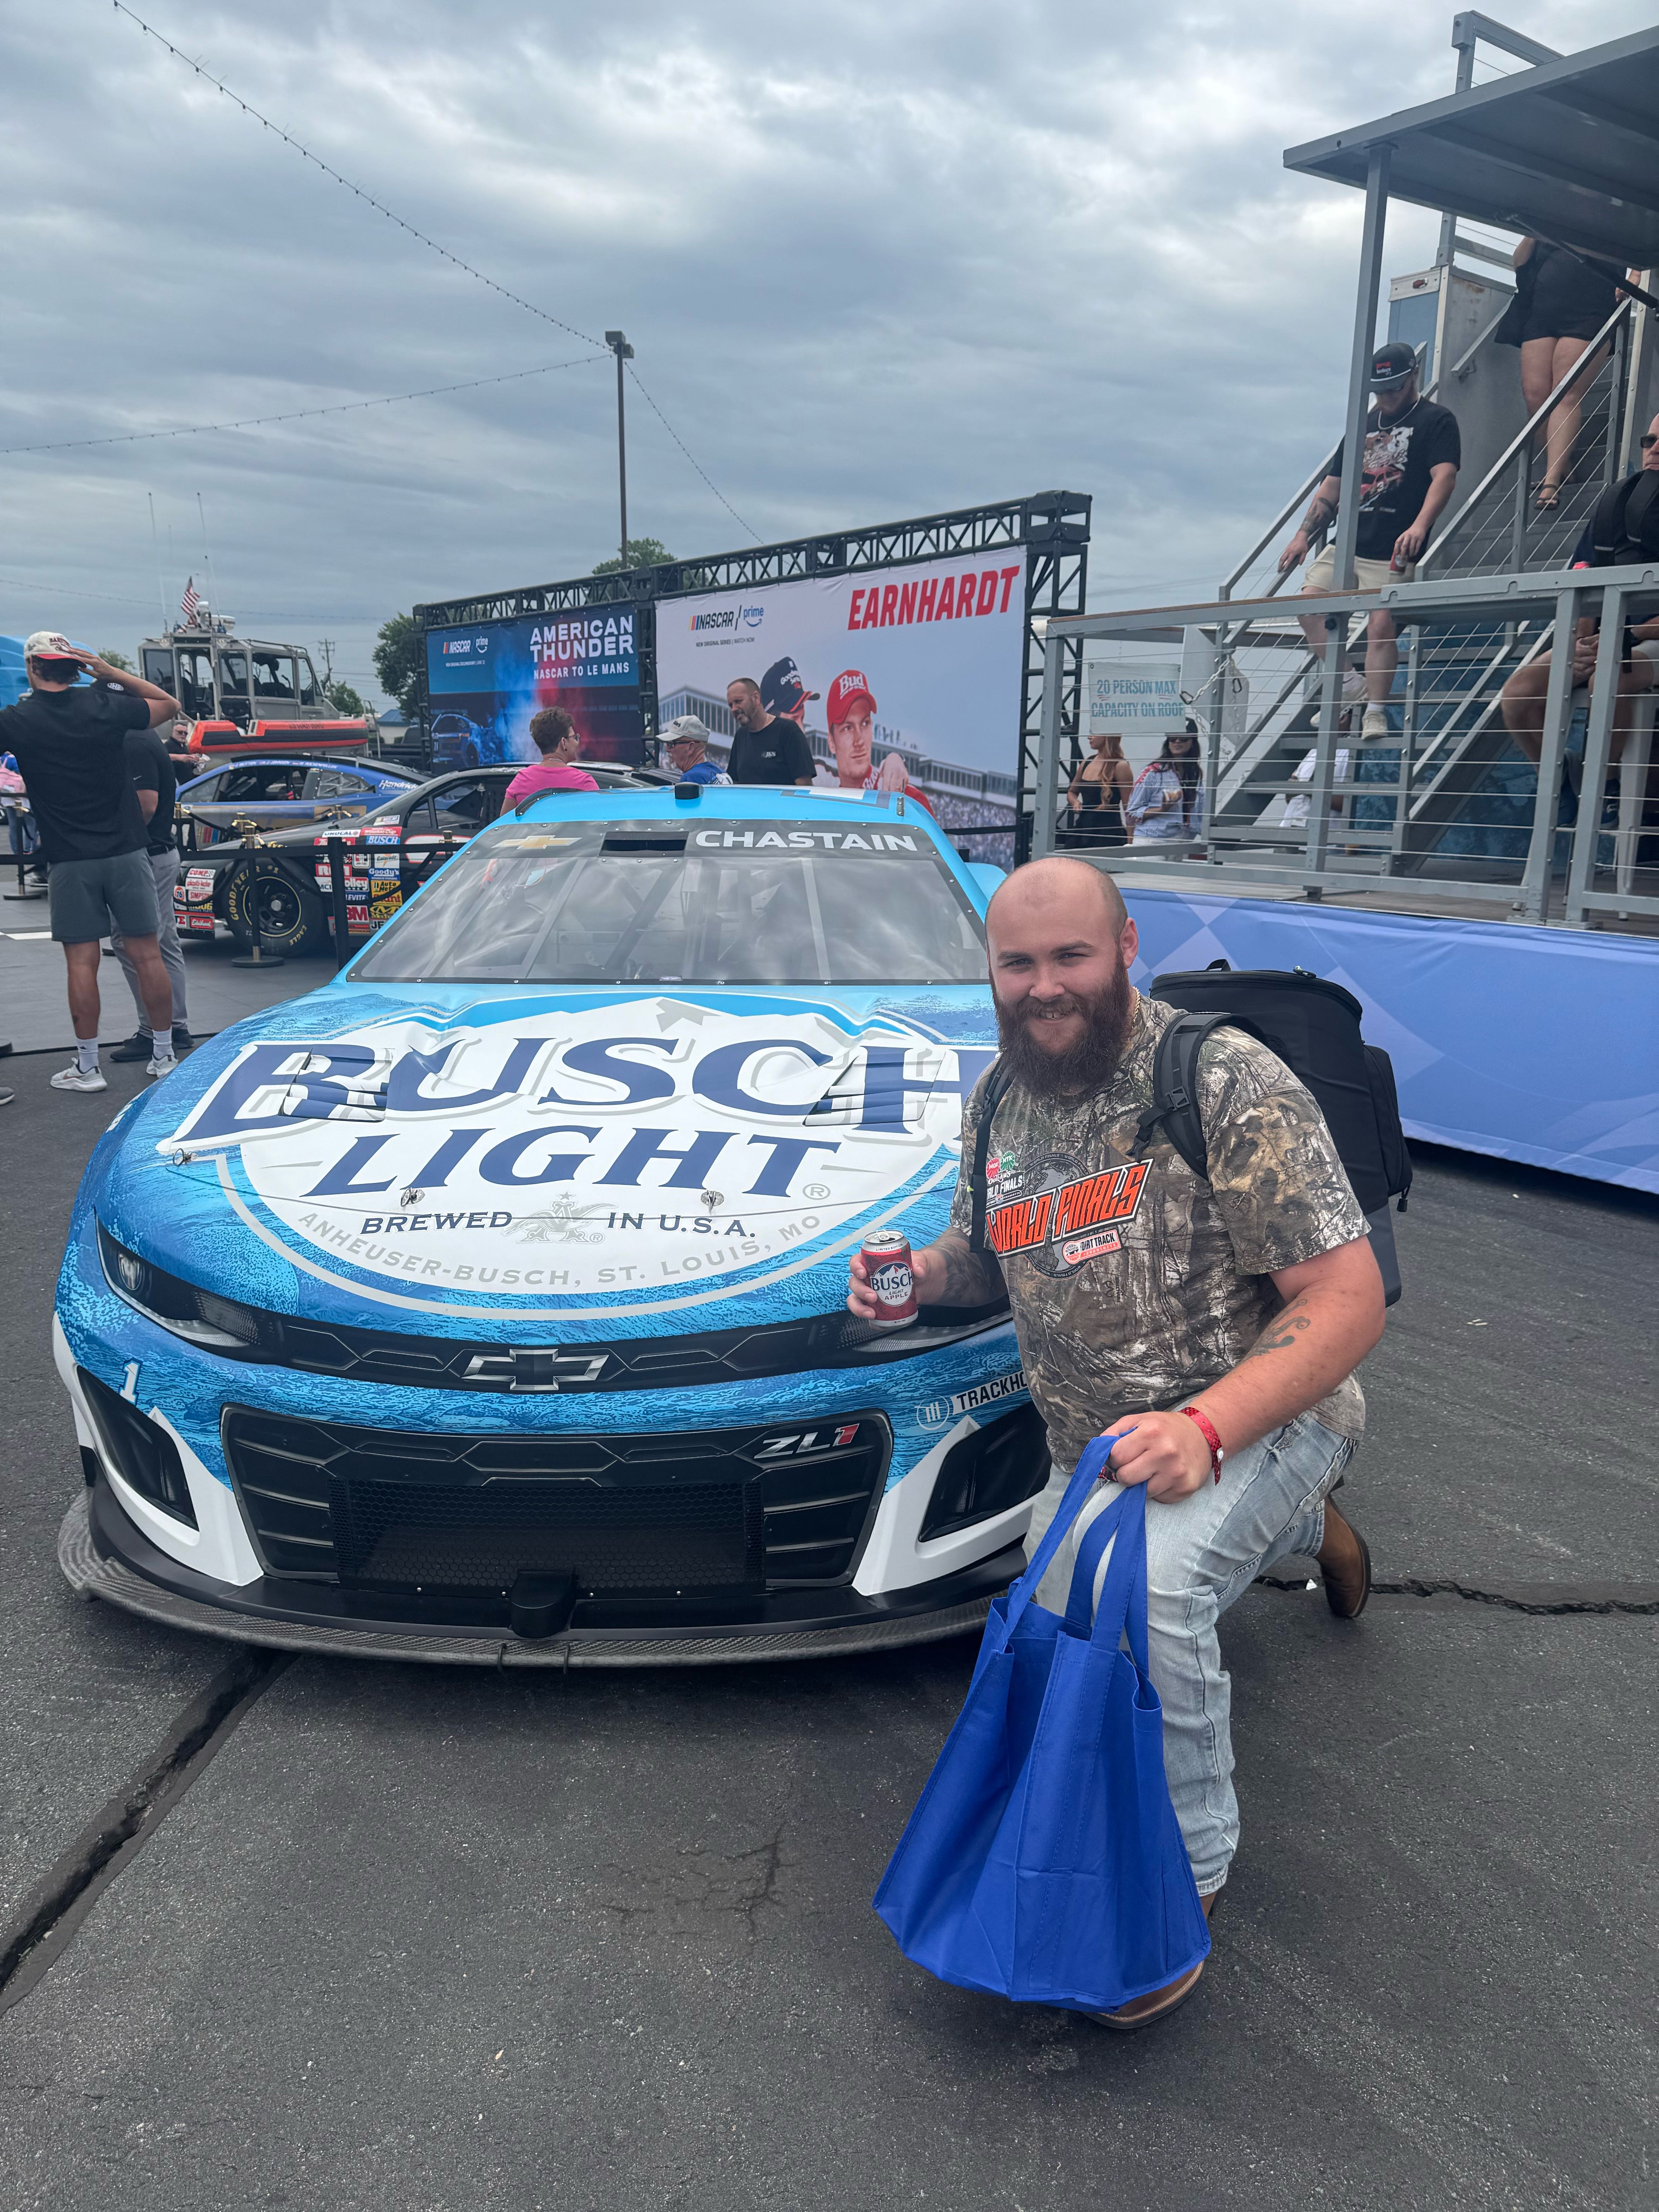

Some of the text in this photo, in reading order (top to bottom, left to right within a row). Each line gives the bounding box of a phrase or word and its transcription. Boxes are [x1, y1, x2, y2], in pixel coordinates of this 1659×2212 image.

[847, 565, 1020, 630] EARNHARDT
[699, 605, 764, 630] NASCAR prime
[530, 615, 633, 644] AMERICAN
[449, 636, 488, 654] NASCAR prime
[530, 634, 634, 663] THUNDER
[534, 662, 629, 680] NASCAR TO LE MANS
[839, 673, 864, 692] Bud
[1097, 680, 1176, 694] 20 PERSON MAX
[1091, 702, 1184, 717] CAPACITY ON ROOF
[696, 830, 918, 851] CHASTAIN
[345, 878, 368, 890] olley
[347, 907, 368, 921] 3M
[172, 1037, 997, 1142] BUSCH
[300, 1125, 842, 1197] LIGHT
[988, 1161, 999, 1170] NGK
[1003, 1155, 1013, 1163] NTK
[1029, 1157, 1044, 1166] WORLD
[1065, 1155, 1078, 1163] WORLD
[1000, 1175, 1023, 1195] FINALS
[987, 1165, 1146, 1252] WORLD FINALS
[360, 1212, 756, 1238] BREWED IN U.S.A.
[299, 1212, 821, 1288] ANHEUSER-BUSCH, ST. LOUIS, MO
[1081, 1238, 1094, 1251] DIRT
[1095, 1233, 1115, 1246] TRACK
[871, 1269, 913, 1291] BUSCH
[885, 1292, 908, 1300] APPLE
[120, 1359, 143, 1405] 1
[957, 1371, 1027, 1410] TRACKHO
[754, 1423, 860, 1459] ZL1
